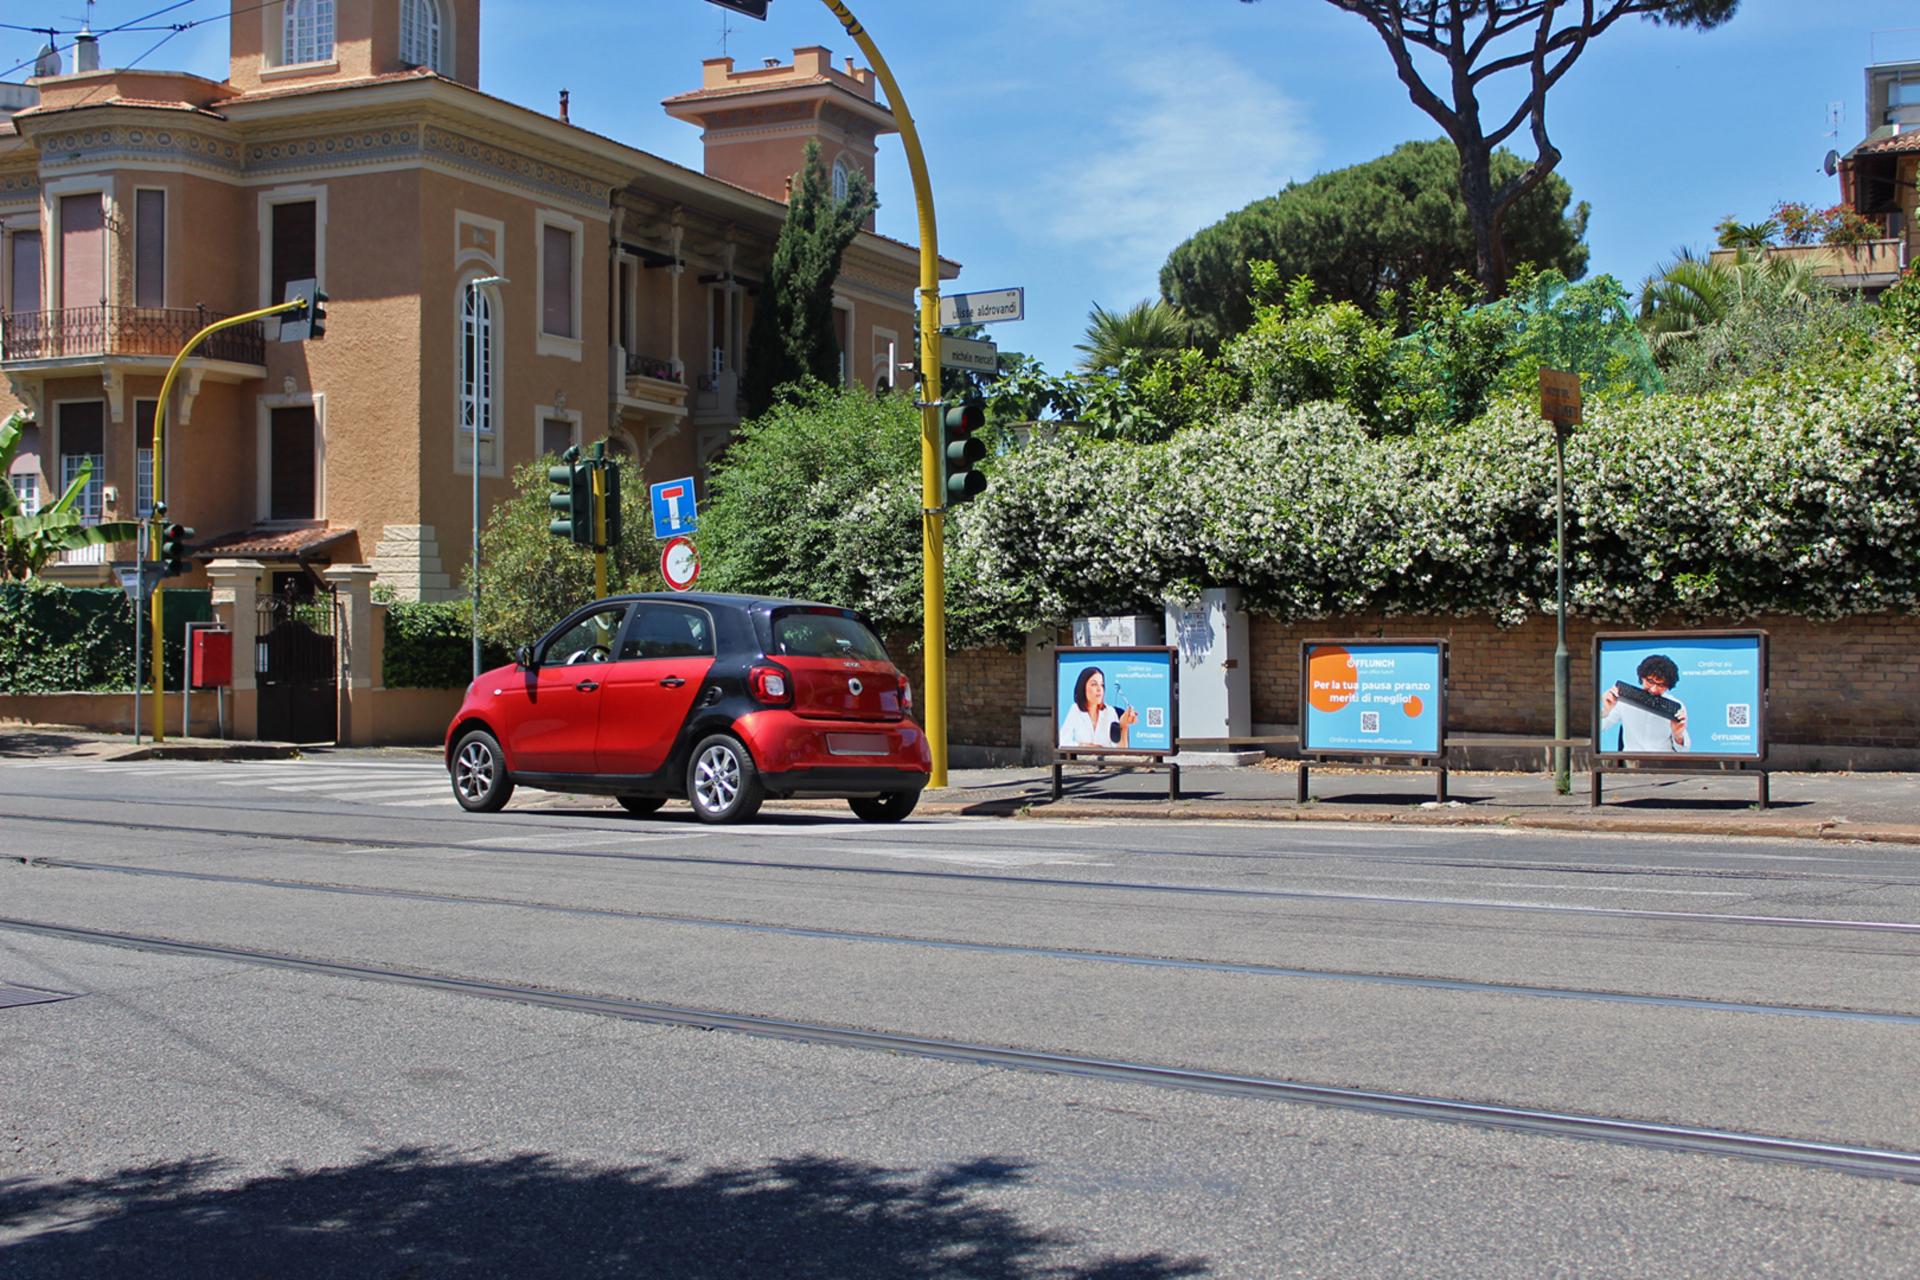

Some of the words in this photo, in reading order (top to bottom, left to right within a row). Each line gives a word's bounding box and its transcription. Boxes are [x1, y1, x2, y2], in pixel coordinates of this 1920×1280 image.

[952, 306, 974, 319] ulisse
[977, 301, 1017, 316] aldrovandi
[1313, 680, 1330, 690] Per
[1332, 680, 1341, 690] la
[1343, 681, 1359, 690] tua
[1361, 682, 1392, 692] pausa
[1394, 682, 1431, 692] pranzo
[1329, 693, 1359, 703] meriti
[1361, 693, 1371, 702] di
[1373, 693, 1412, 705] meglio!
